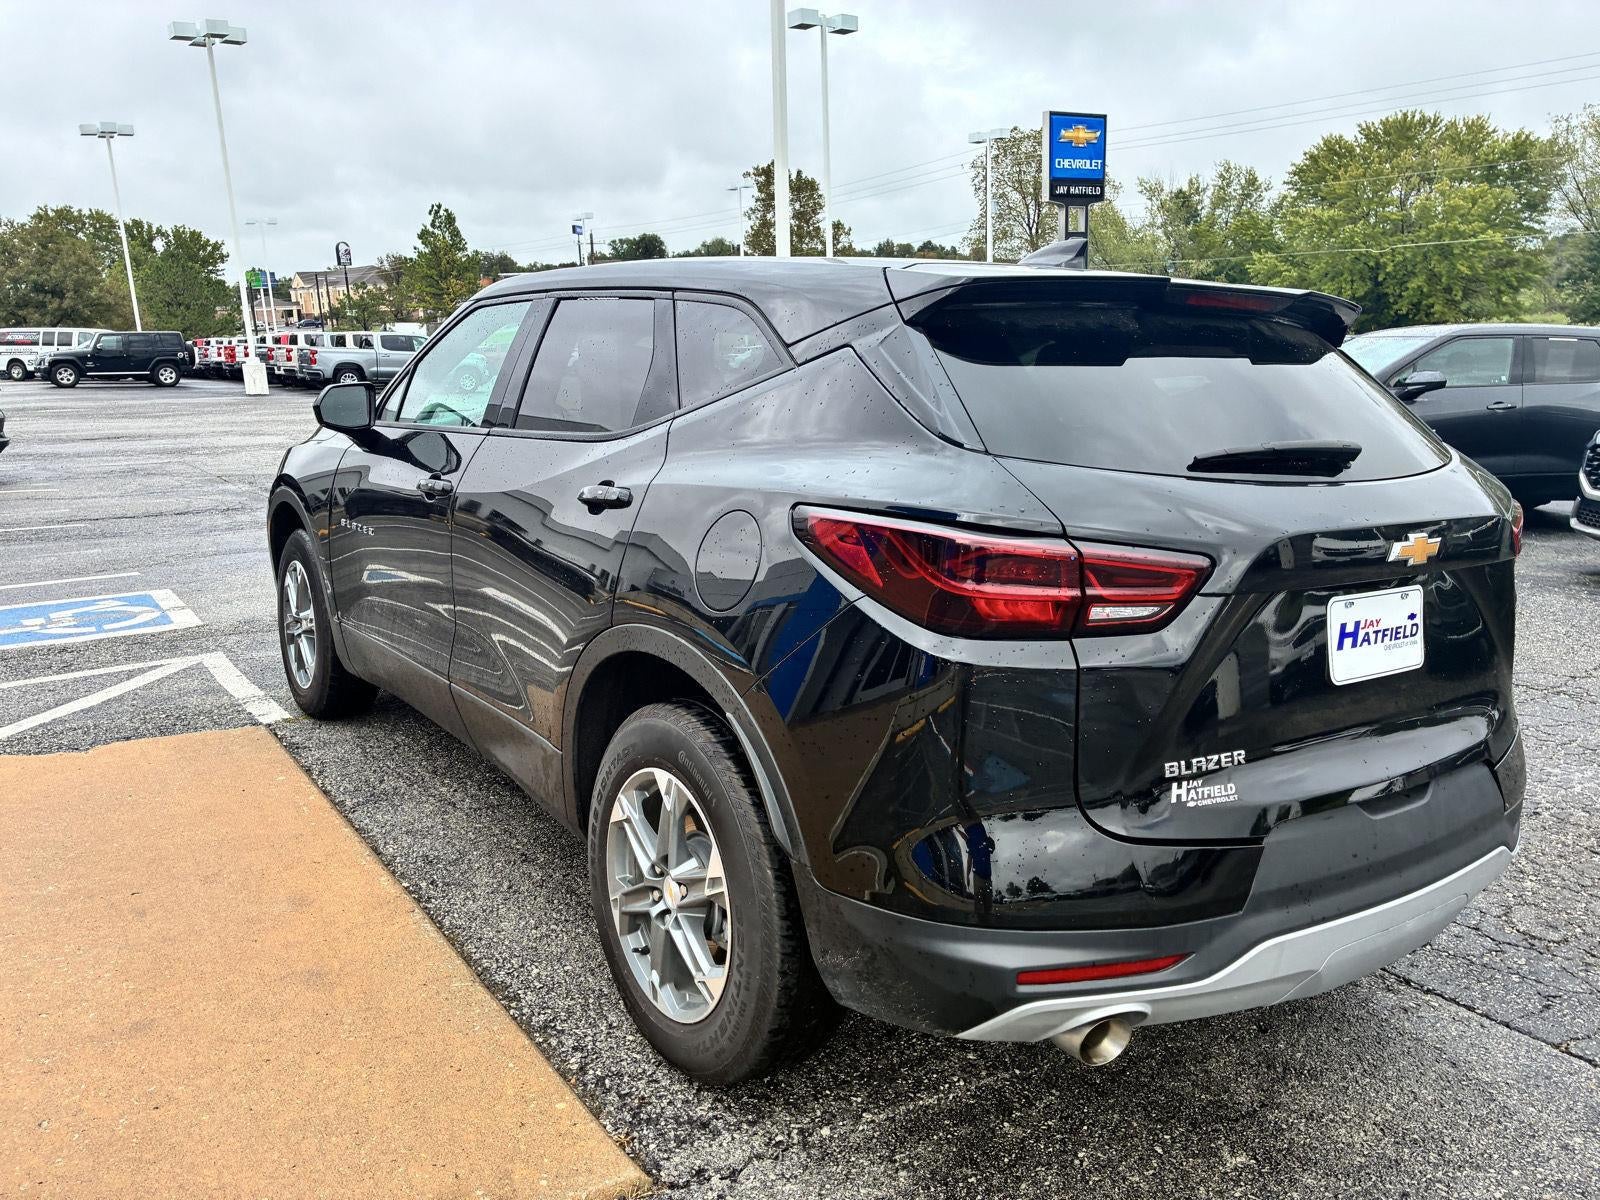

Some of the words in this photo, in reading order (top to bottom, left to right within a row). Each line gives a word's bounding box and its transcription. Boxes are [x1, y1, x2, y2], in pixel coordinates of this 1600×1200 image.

[1055, 158, 1103, 170] CHEVROLET
[1055, 185, 1068, 195] JAY
[1069, 186, 1101, 195] HATFIELD
[340, 518, 375, 536] BLAZER
[1361, 618, 1382, 631] JAY
[1336, 620, 1419, 651] HATFIELD
[1164, 750, 1246, 778] BLAZER
[1187, 779, 1203, 789] JAY
[1170, 780, 1236, 804] HATFIELD
[1197, 794, 1239, 807] CHEVROLET
